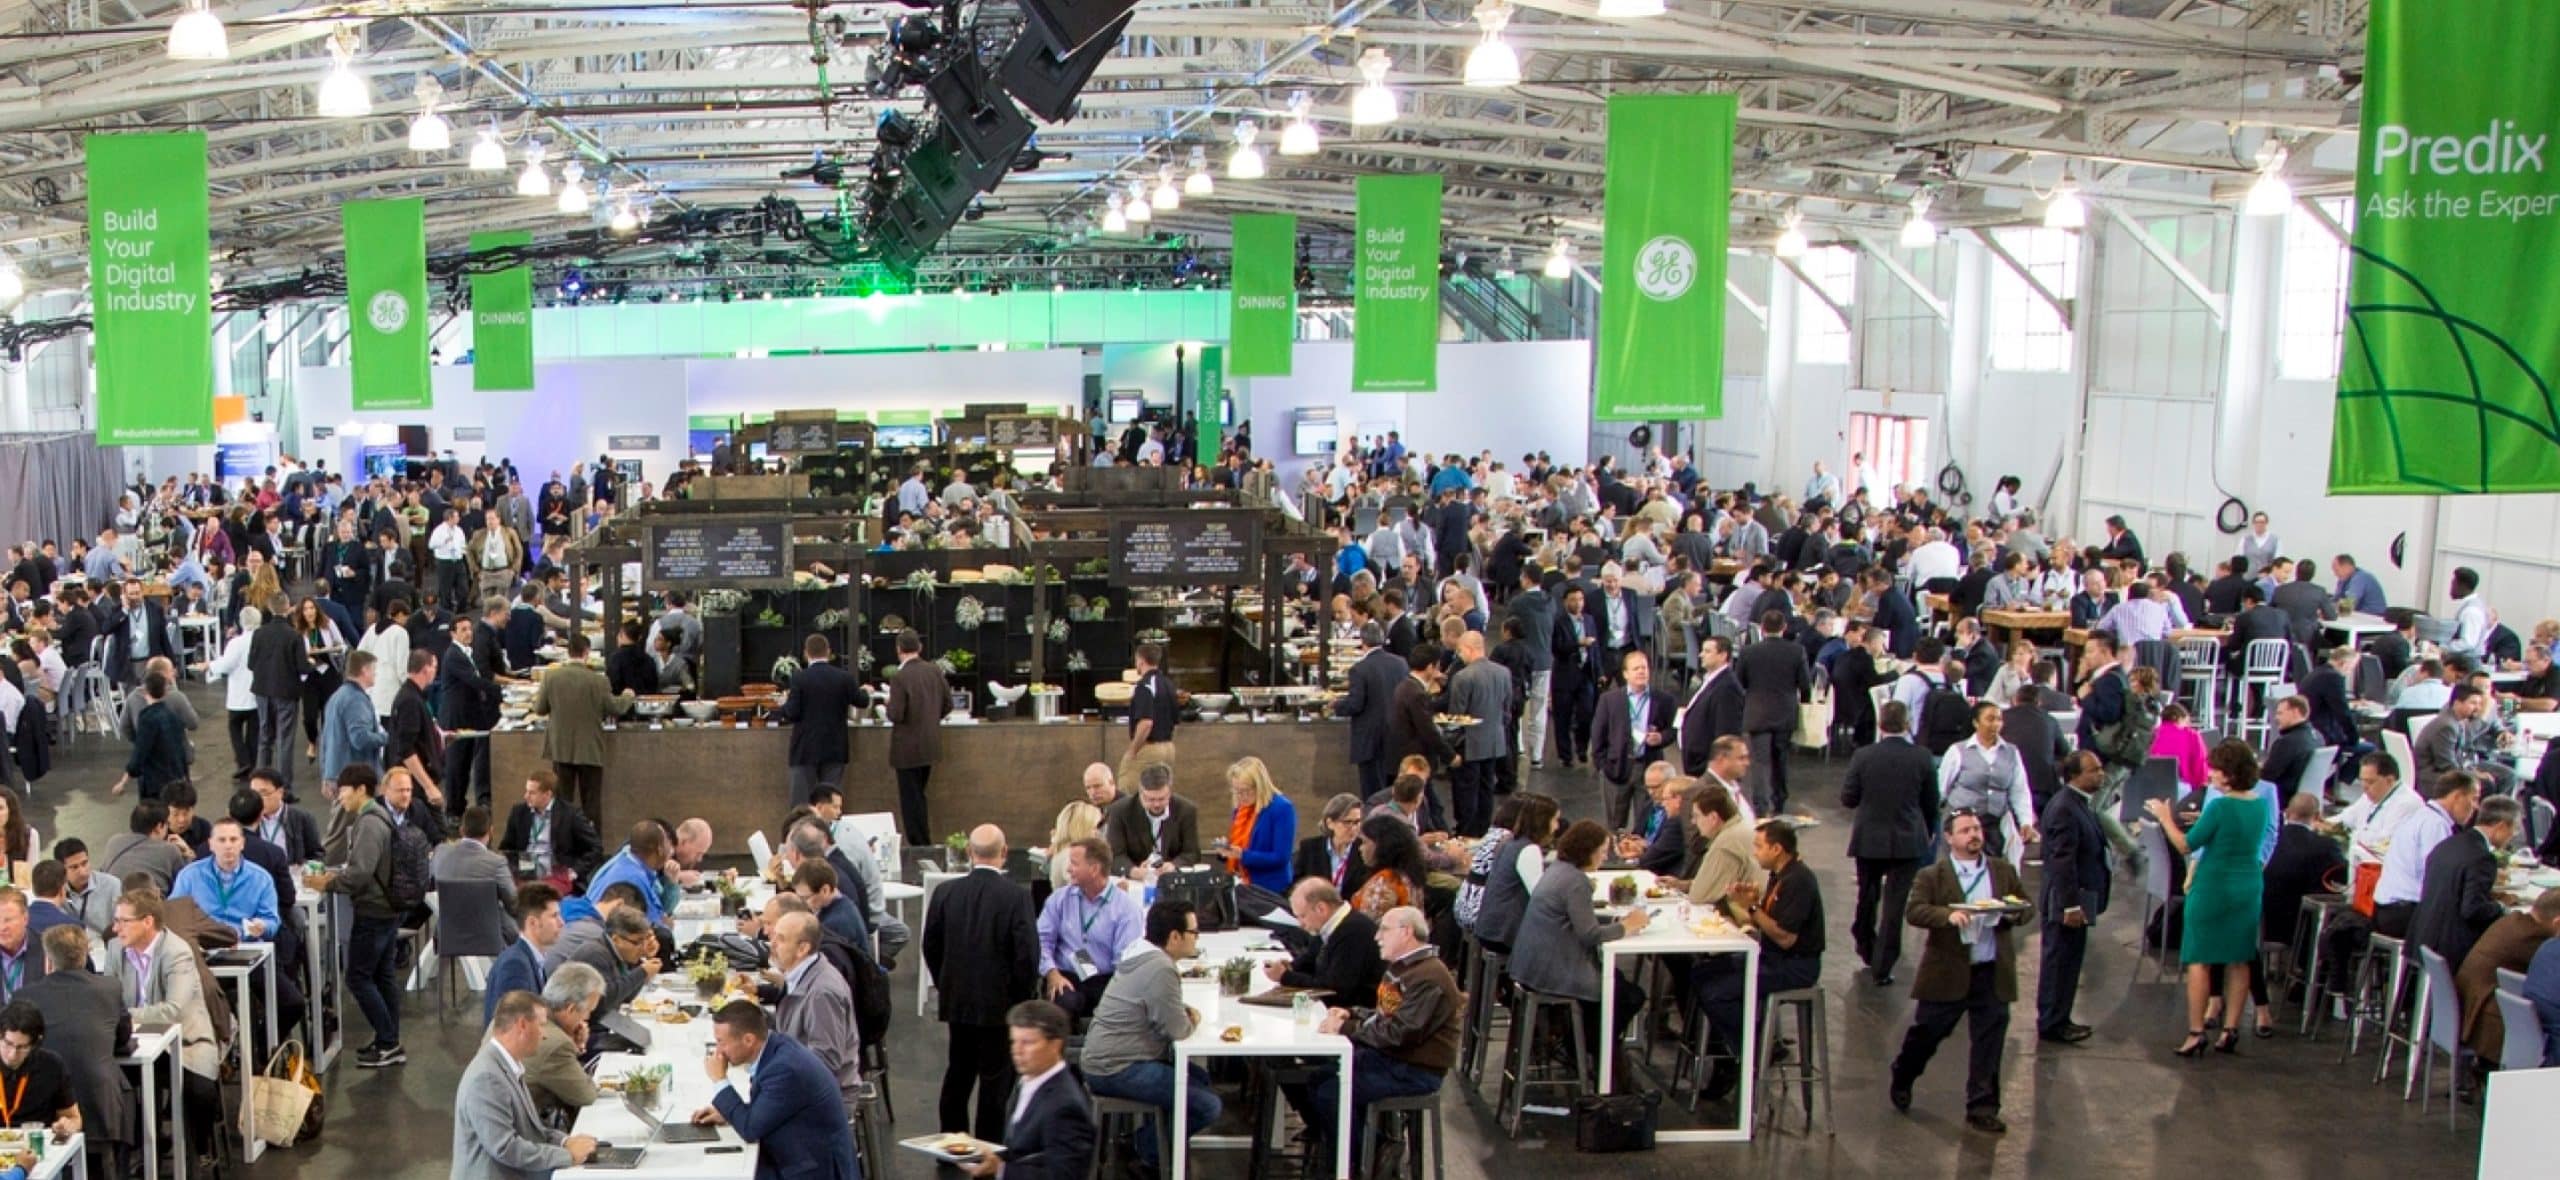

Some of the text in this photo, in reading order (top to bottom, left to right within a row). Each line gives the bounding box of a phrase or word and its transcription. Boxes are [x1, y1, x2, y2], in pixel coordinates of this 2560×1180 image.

[2373, 118, 2546, 176] Predix
[2365, 190, 2416, 219] Ask
[2424, 190, 2470, 218] the
[104, 208, 157, 231] Build
[1365, 227, 1405, 243] Build
[104, 238, 154, 257] Your
[1365, 247, 1401, 262] Your
[106, 262, 175, 289] Digital
[1365, 264, 1415, 285] Digital
[107, 290, 196, 315] Industry
[1239, 295, 1285, 309] DINING
[1365, 285, 1429, 301] Industry
[480, 311, 526, 325] DINING
